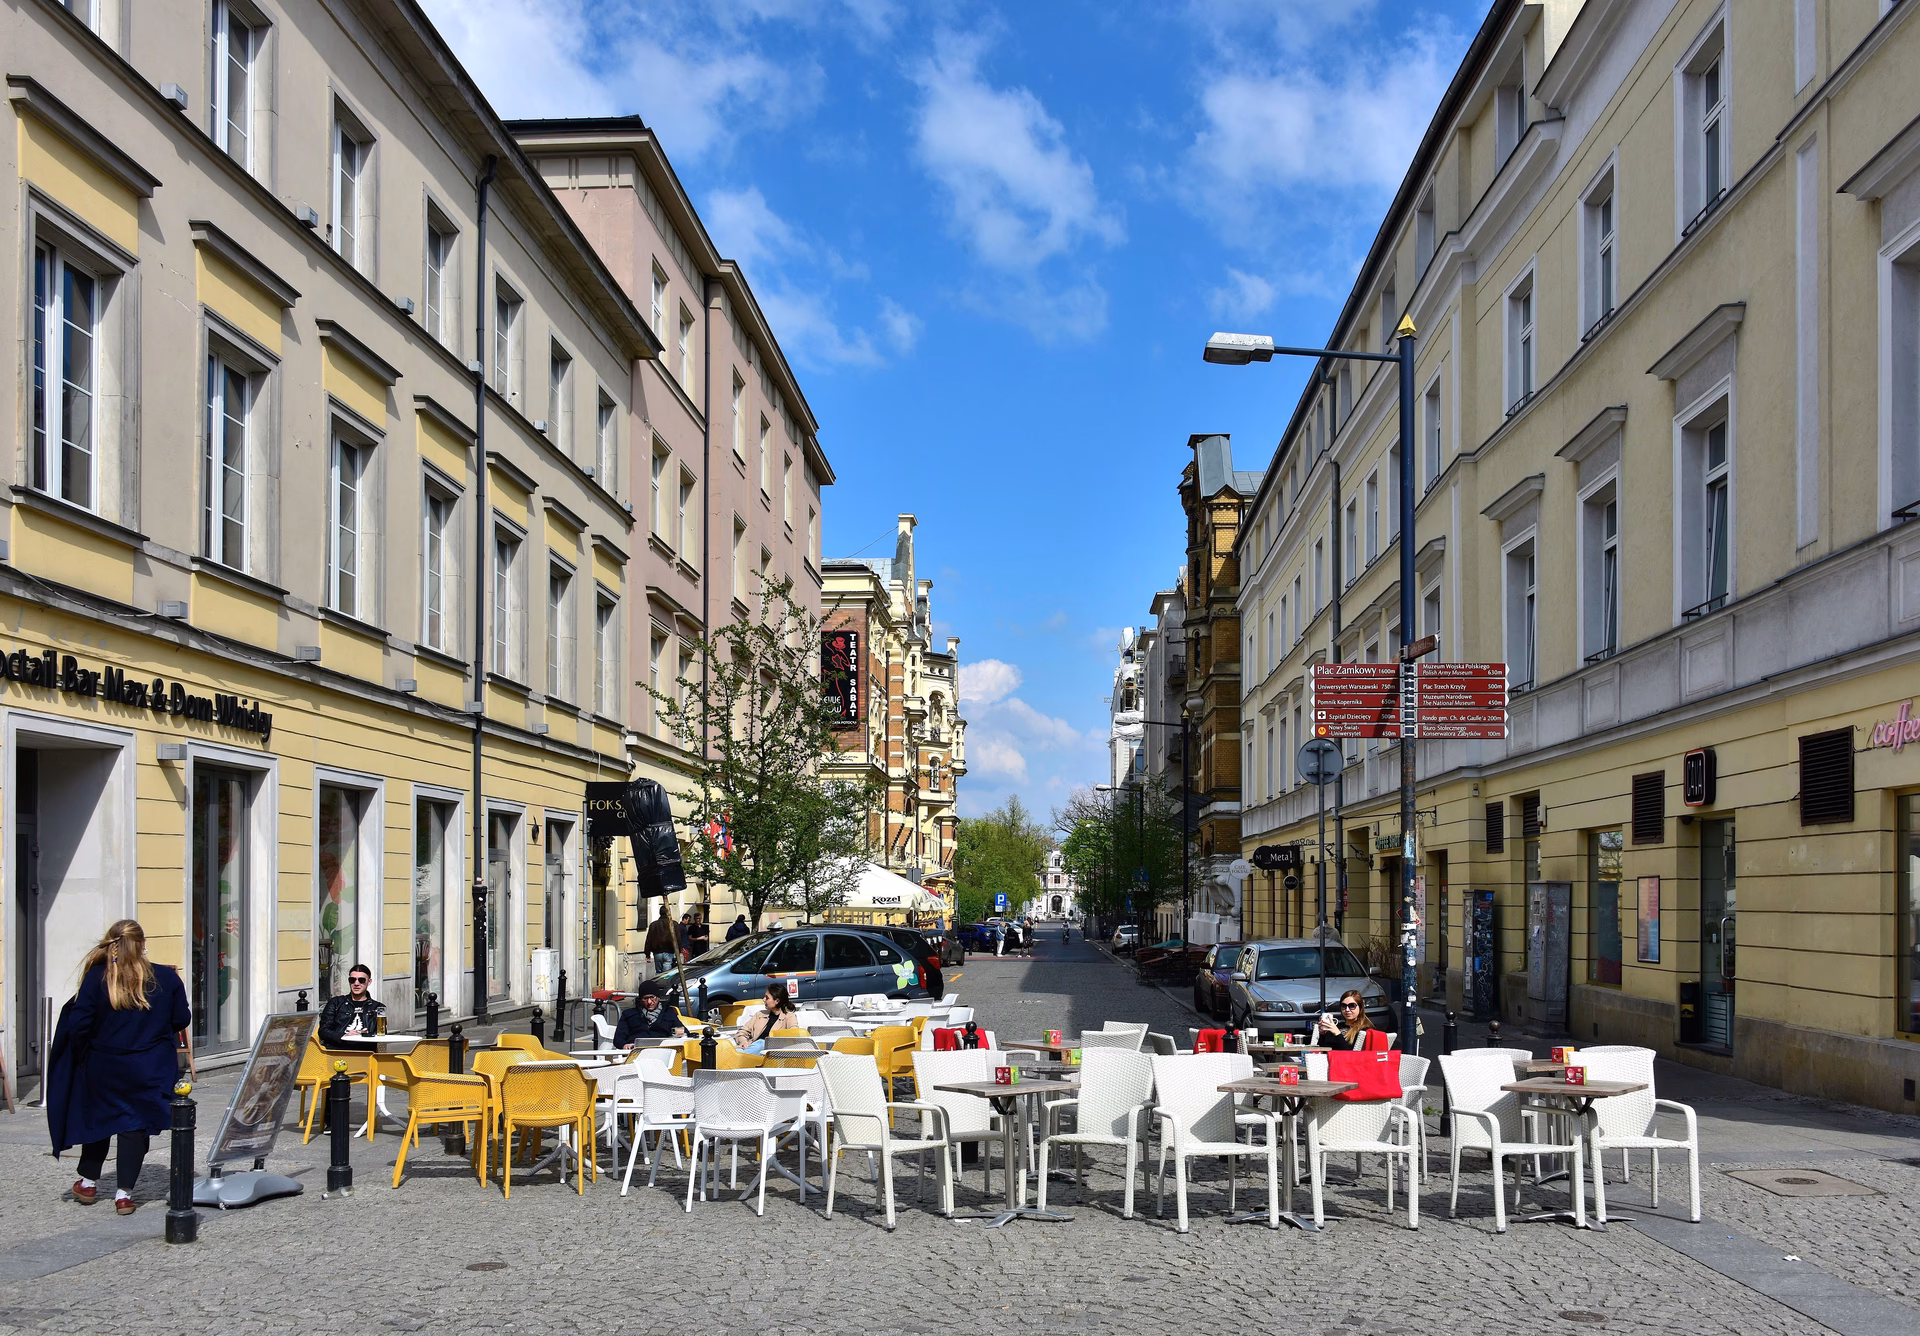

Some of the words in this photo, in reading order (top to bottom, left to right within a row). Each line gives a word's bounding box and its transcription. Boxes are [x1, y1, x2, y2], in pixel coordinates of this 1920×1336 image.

[1317, 666, 1334, 675] Plac
[1336, 665, 1376, 677] Zamkowy
[62, 655, 101, 698] Bar
[104, 666, 149, 708] Max
[151, 678, 167, 712] &
[170, 682, 213, 722] Dom
[215, 693, 272, 743] Whisky
[590, 799, 624, 810] FOKS
[872, 896, 901, 905] Kozel
[998, 894, 1004, 904] P
